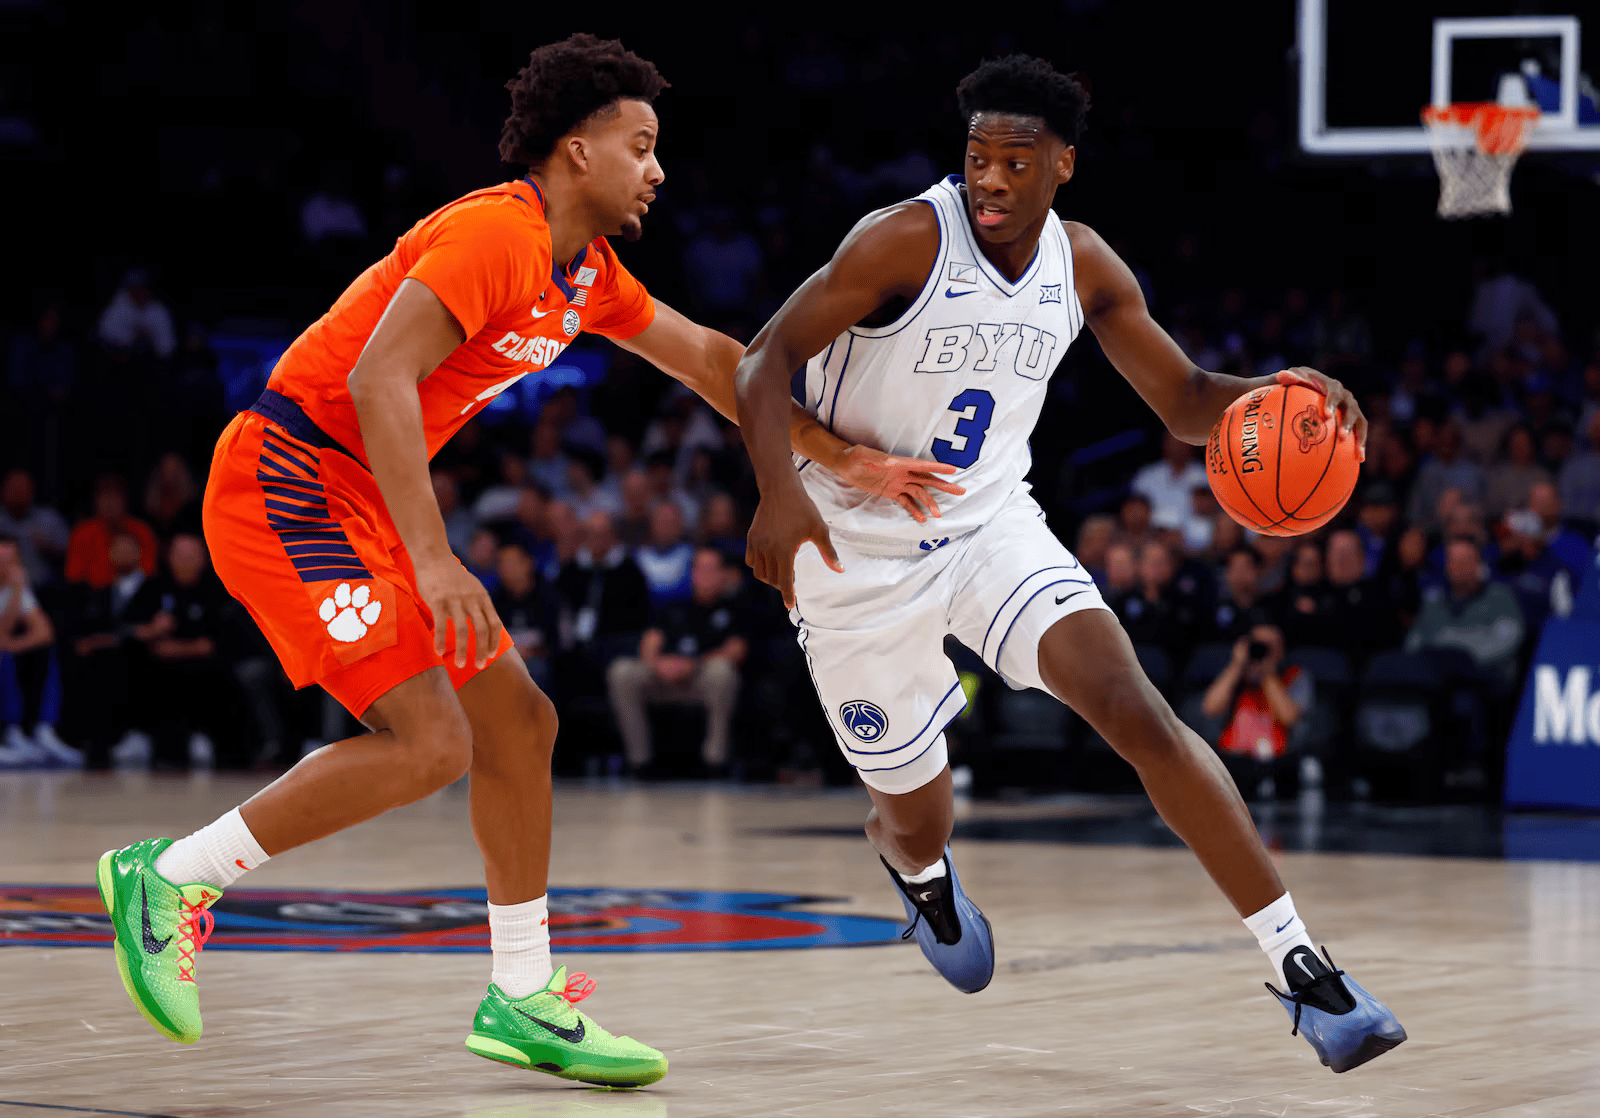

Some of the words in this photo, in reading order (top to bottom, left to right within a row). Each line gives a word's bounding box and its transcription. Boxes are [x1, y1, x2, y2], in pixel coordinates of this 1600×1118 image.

[914, 323, 1057, 381] BYU
[931, 389, 996, 469] 3
[858, 725, 872, 736] Y
